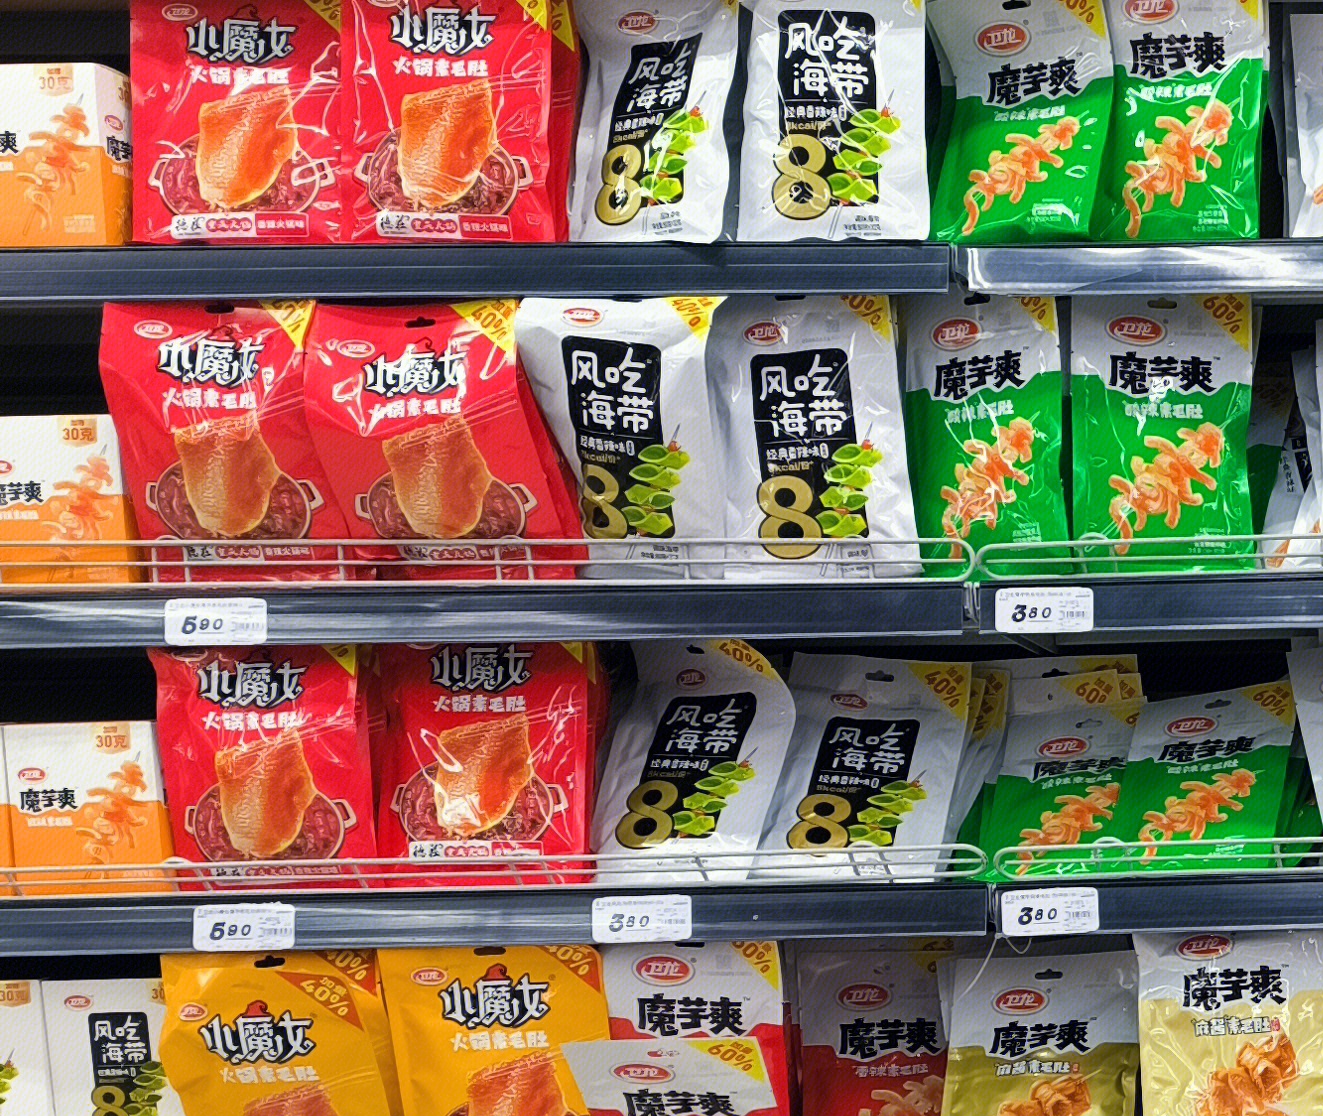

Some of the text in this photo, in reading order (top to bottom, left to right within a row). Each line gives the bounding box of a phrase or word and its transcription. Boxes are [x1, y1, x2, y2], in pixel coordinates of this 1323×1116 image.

[647, 958, 682, 982] 卫龙
[637, 993, 743, 1038] 魔芋爽
[838, 1016, 942, 1059] 魔芋爽
[990, 1019, 1091, 1058] 魔芋爽
